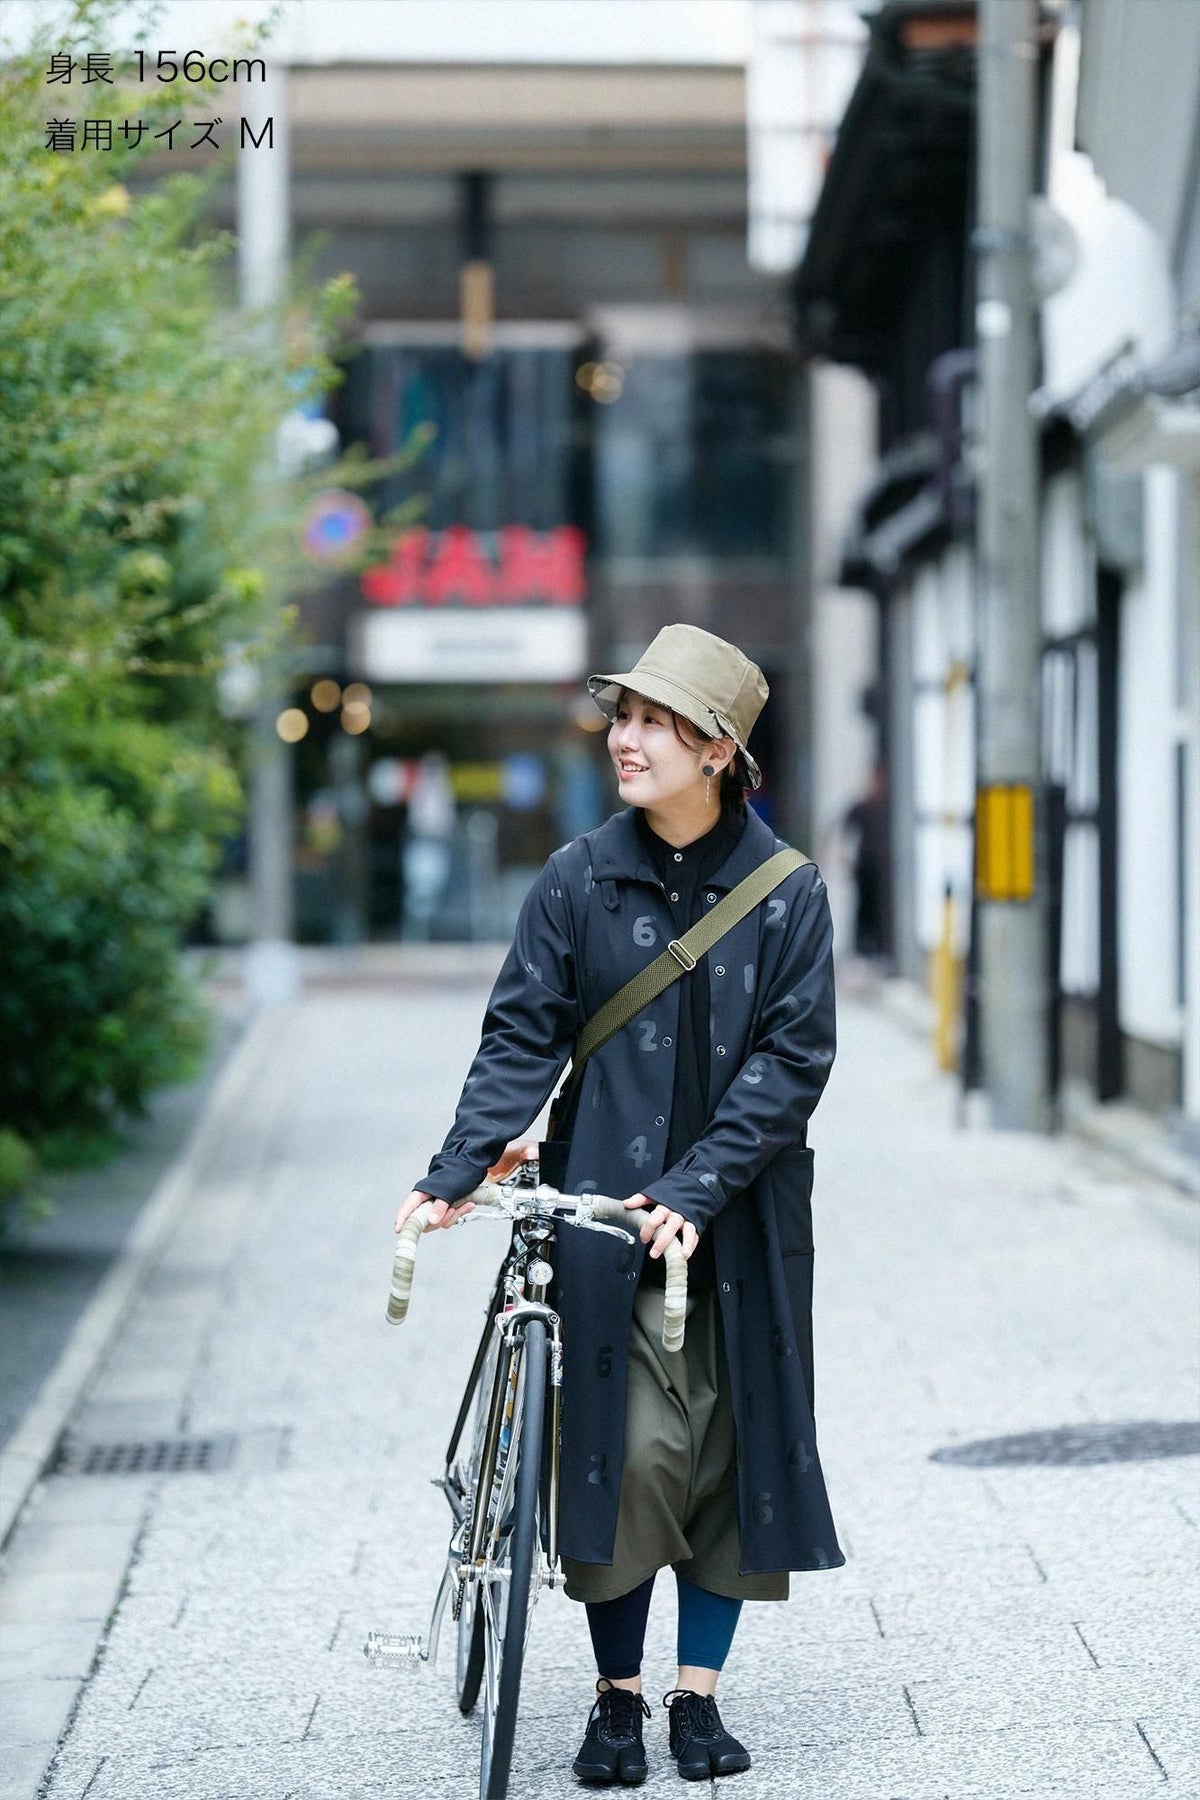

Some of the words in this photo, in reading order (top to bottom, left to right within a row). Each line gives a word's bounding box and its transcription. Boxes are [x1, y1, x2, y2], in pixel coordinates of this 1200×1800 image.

[632, 915, 658, 947] 6
[638, 1020, 657, 1052] 2
[624, 1135, 653, 1168] 4
